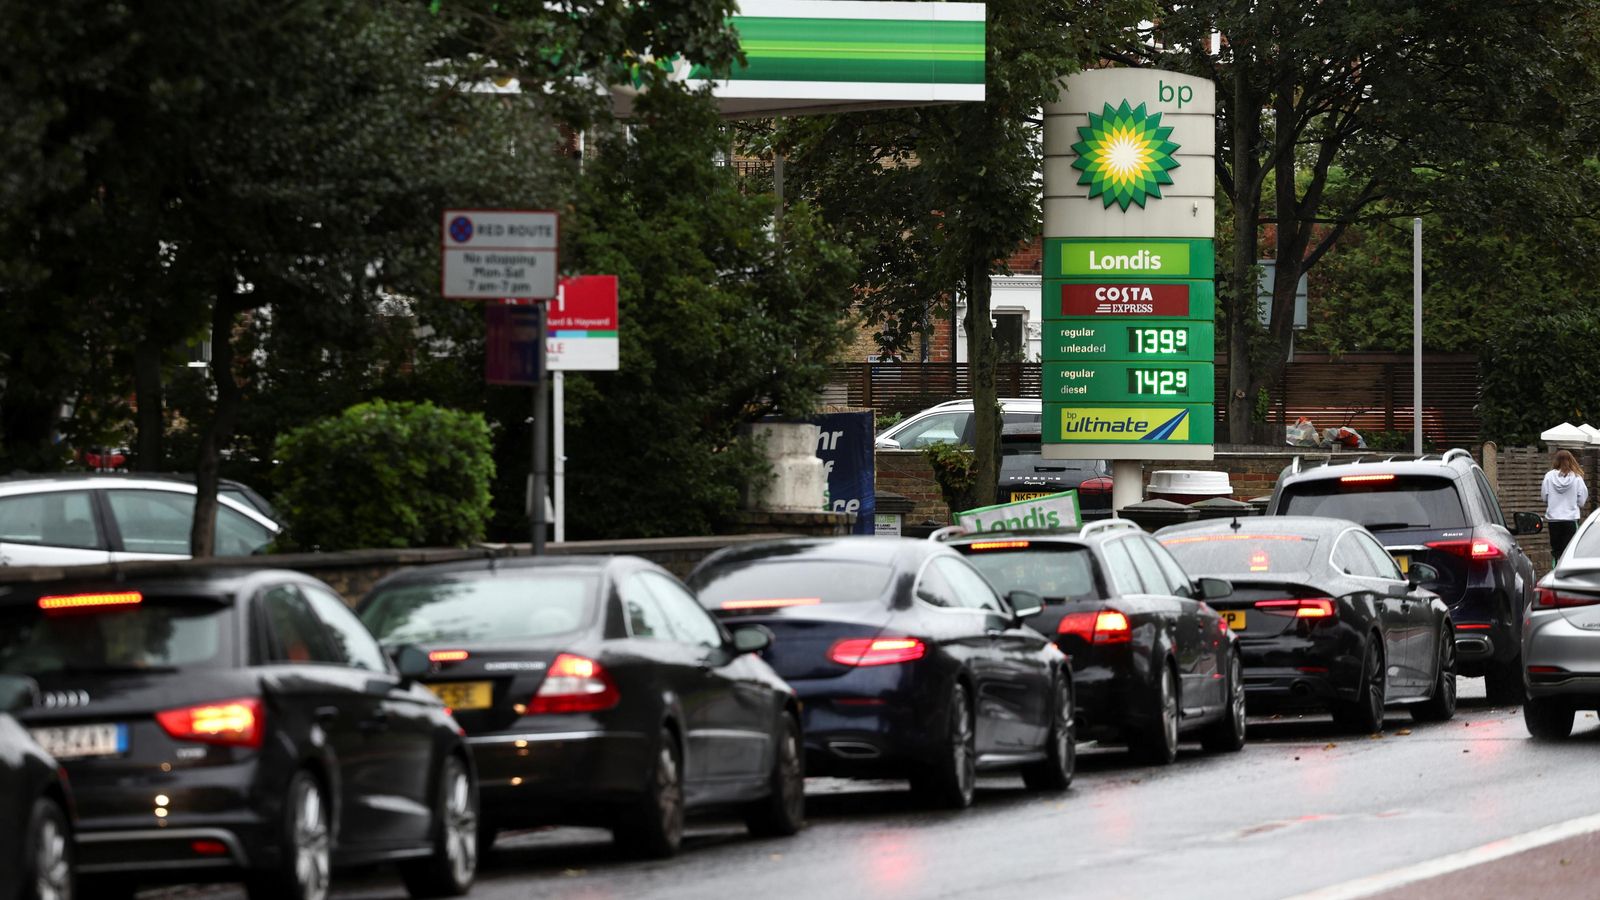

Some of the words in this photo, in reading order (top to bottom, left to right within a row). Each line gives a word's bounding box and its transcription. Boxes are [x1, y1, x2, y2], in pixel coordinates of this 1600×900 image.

[1159, 80, 1193, 109] bp
[478, 225, 503, 236] RED
[508, 225, 552, 238] ROUTE
[464, 254, 482, 263] No
[485, 254, 536, 266] stopping
[1089, 250, 1162, 270] Londis
[474, 268, 525, 278] Mon-Sat
[512, 284, 531, 293] pm
[1095, 287, 1153, 302] COSTA
[1112, 304, 1153, 313] EXPRESS
[1060, 328, 1095, 338] regular
[1060, 344, 1106, 353] unleaded
[1060, 369, 1095, 379] regular
[1060, 385, 1087, 394] diesel
[1066, 411, 1077, 420] bp
[1066, 416, 1148, 433] ultimate
